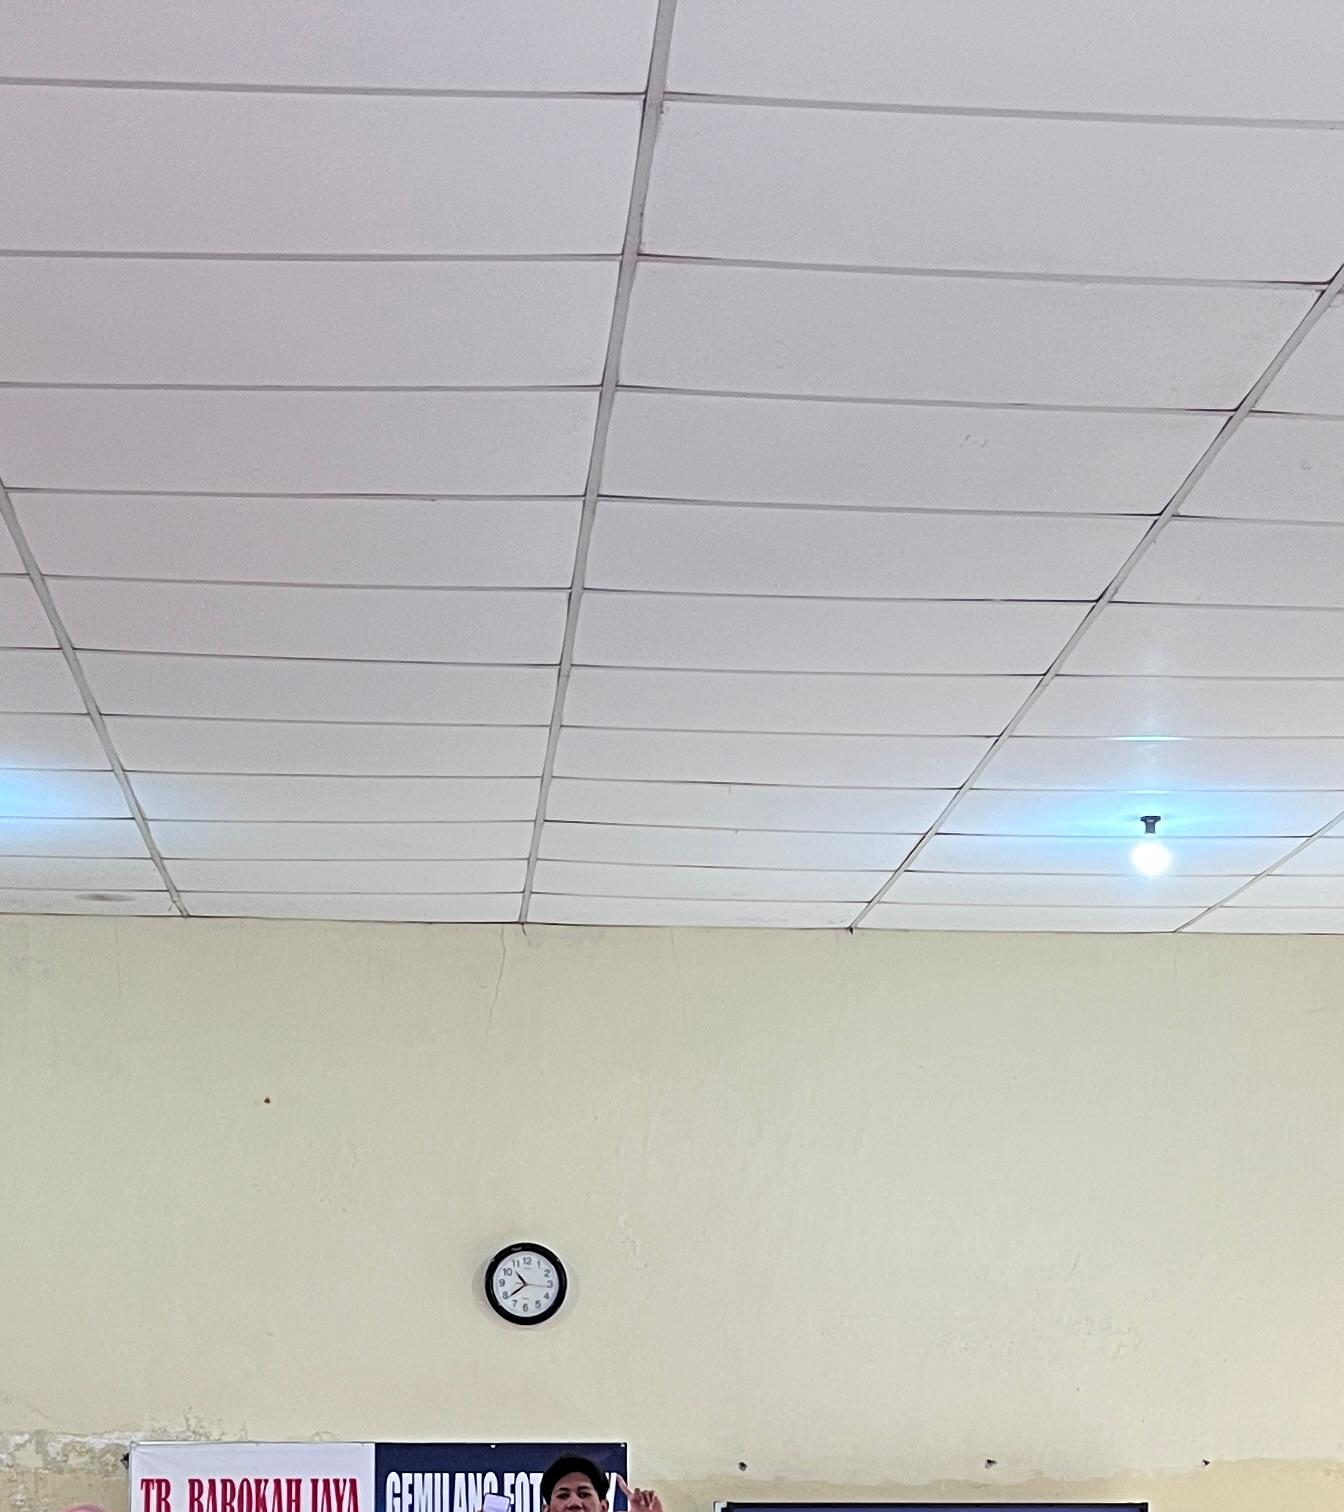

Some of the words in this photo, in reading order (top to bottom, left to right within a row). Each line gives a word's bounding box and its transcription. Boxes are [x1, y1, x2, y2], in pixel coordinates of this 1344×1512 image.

[512, 1259, 520, 1267] 11
[523, 1257, 532, 1265] 12
[503, 1268, 512, 1276] 10
